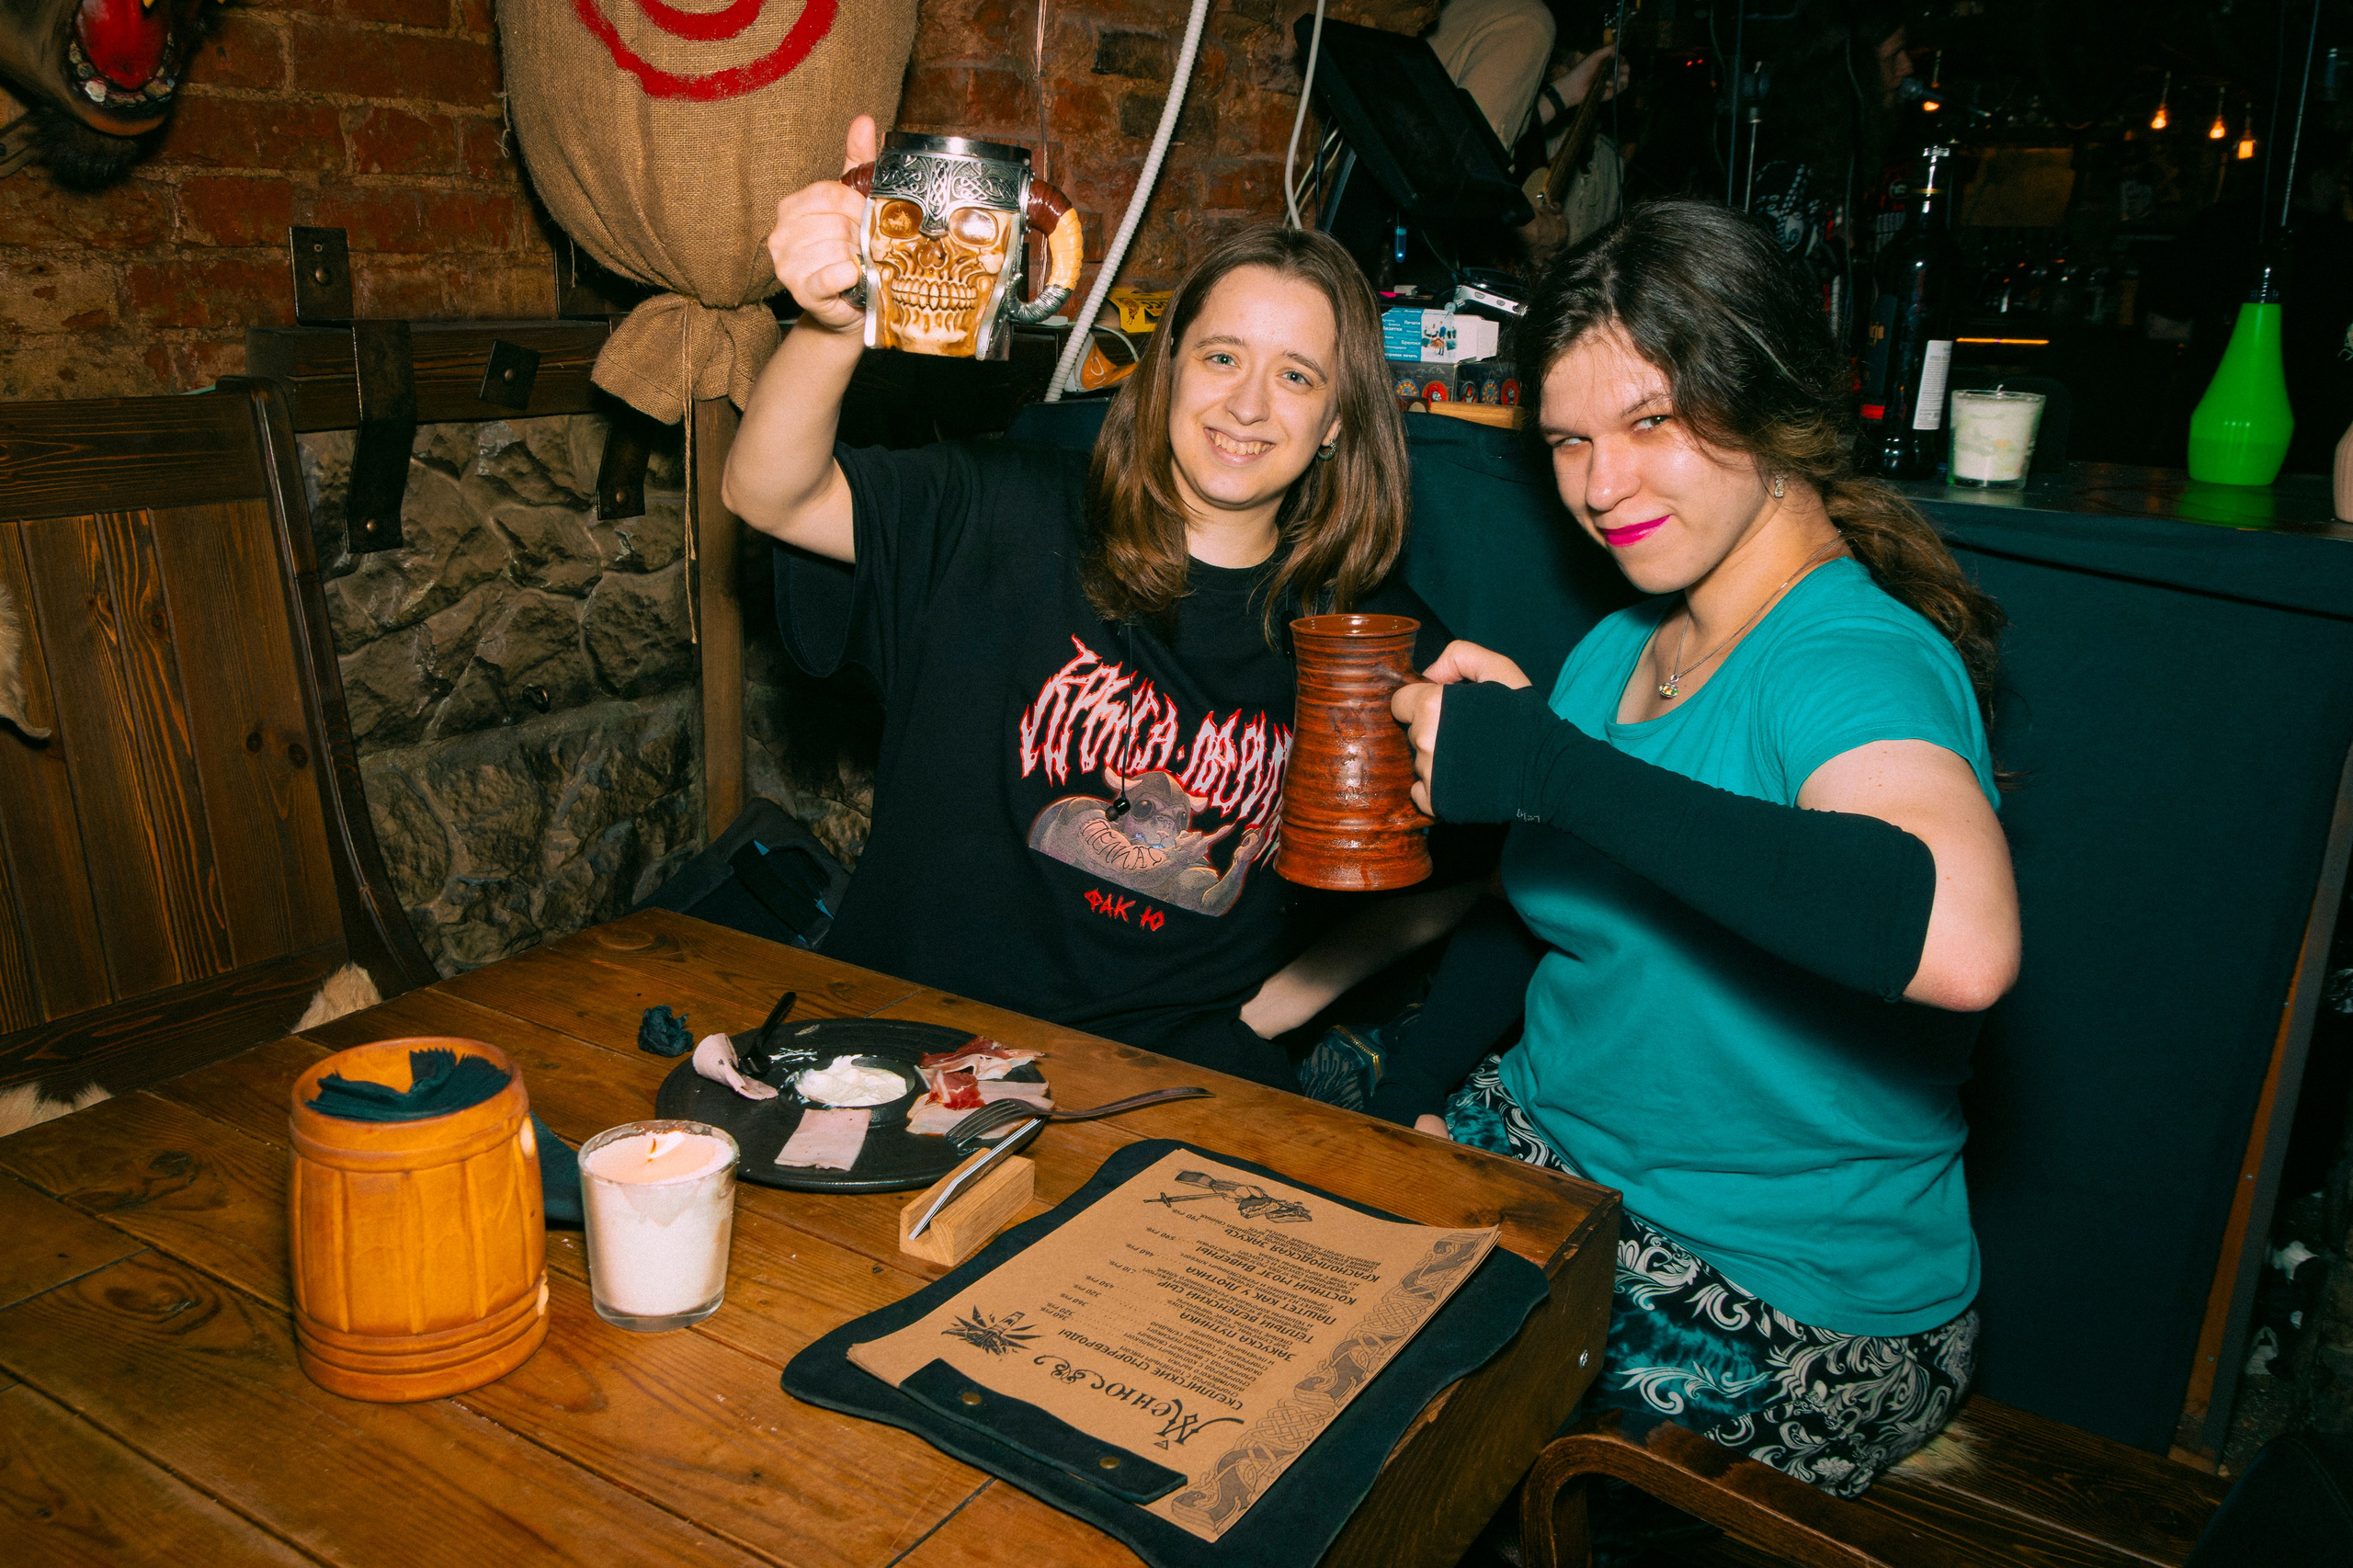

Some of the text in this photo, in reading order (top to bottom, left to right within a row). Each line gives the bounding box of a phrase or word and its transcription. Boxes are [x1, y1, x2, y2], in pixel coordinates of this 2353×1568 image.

[1084, 888, 1165, 931] ФАК Ю
[1221, 1227, 1269, 1248] ЗАКУСЬ
[1194, 1244, 1256, 1273] ВИВЕРНЫ
[1268, 1244, 1381, 1283] КРАСНОЛЮДСКАЯ
[1155, 1278, 1186, 1294] СЫР
[1182, 1266, 1242, 1292] ЛЮТИКА
[1255, 1267, 1293, 1285] МОЗГ
[1239, 1287, 1253, 1296] У
[1250, 1291, 1280, 1306] КАК
[1290, 1280, 1358, 1306] КОСТНЫЙ
[1183, 1290, 1259, 1323] ВЕЛЕНСКИЙ
[1279, 1301, 1337, 1325] ПАШТЕТ
[1176, 1311, 1237, 1338] ПУТНИКА
[1256, 1319, 1316, 1345] ТЁПЛЫЙ
[1236, 1334, 1297, 1362] ЗАКУСКА
[1057, 1327, 1245, 1411] СКЕЛЛИГСКИЕ СМОРРЕБРОДЫ
